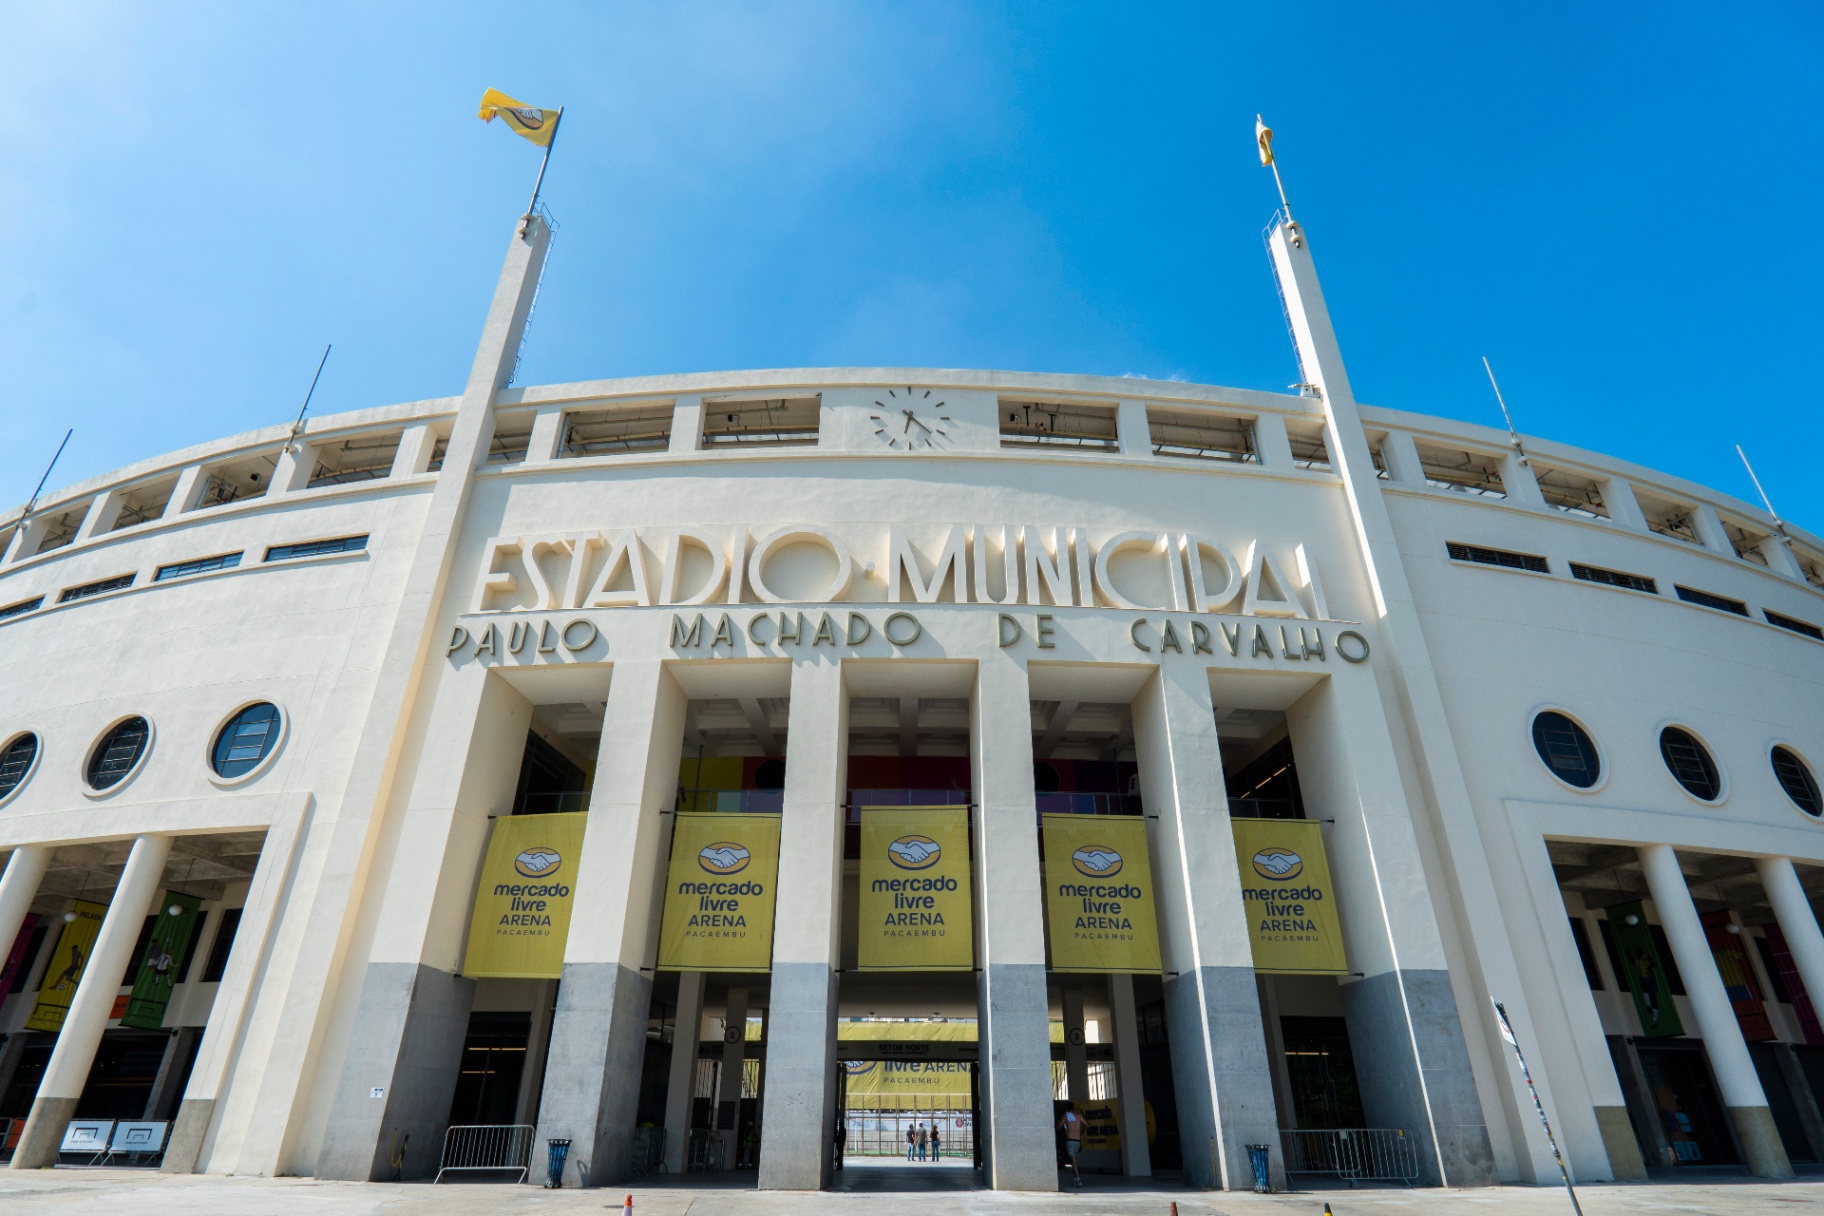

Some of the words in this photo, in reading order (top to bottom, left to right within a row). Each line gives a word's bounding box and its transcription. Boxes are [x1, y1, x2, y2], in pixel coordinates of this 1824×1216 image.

[470, 524, 853, 614] ESTADIO
[446, 617, 598, 658] PAULO
[670, 611, 921, 648] MACHADO
[998, 613, 1056, 648] DE
[1129, 617, 1371, 664] CARVALHO
[493, 883, 570, 897] mercado
[678, 881, 763, 896] mercado
[872, 875, 958, 892] mercado
[1059, 884, 1142, 899] mercado
[1242, 885, 1323, 900] mercado
[510, 897, 547, 912] livre
[699, 896, 739, 912] livre
[894, 893, 935, 909] livre
[1082, 898, 1122, 914] livre
[1265, 901, 1305, 916] livre
[499, 915, 552, 926] ARENA
[688, 915, 747, 927] ARENA
[884, 913, 945, 926] ARENA
[1075, 917, 1133, 930] ARENA
[1260, 919, 1317, 931] ARENA
